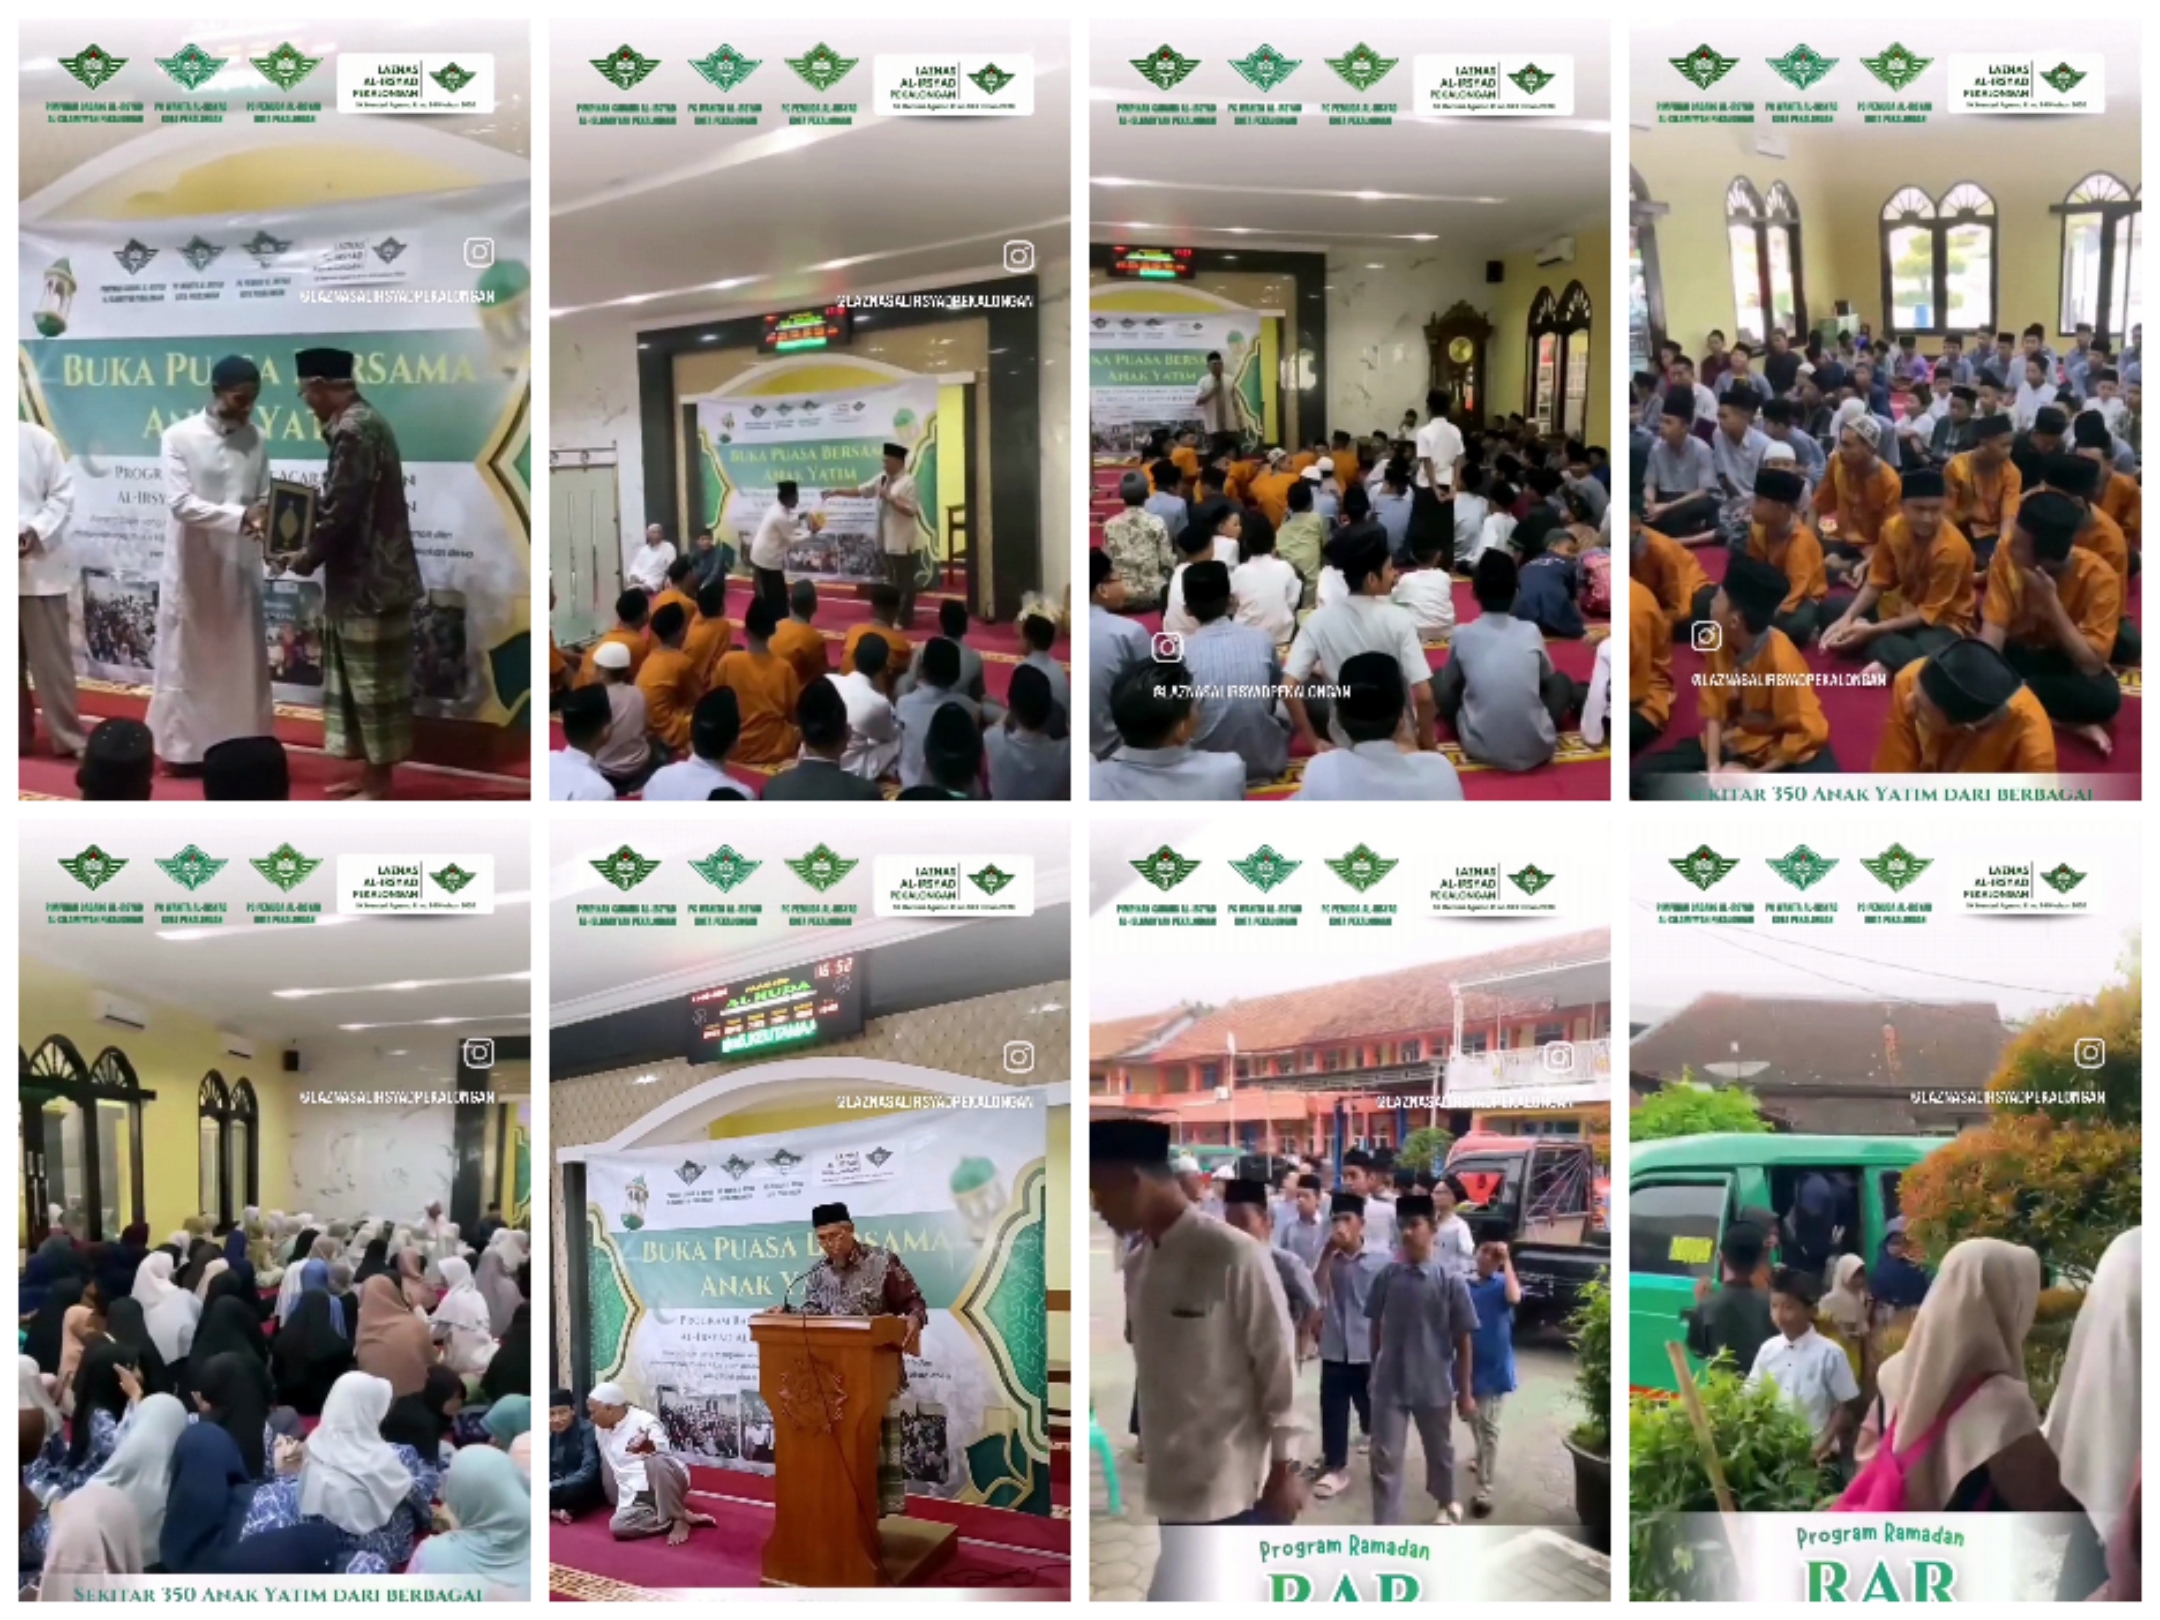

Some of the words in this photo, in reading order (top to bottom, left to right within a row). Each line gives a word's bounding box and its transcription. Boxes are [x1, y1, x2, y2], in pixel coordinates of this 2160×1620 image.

[64, 353, 156, 386] BUKA
[166, 351, 281, 386] PUA
[730, 450, 767, 462] BUKA
[771, 448, 818, 462] PUASA
[806, 466, 857, 481] YATIM
[642, 1240, 708, 1264] BUKA
[714, 1236, 798, 1261] PUASA
[701, 1274, 774, 1298] ANAK
